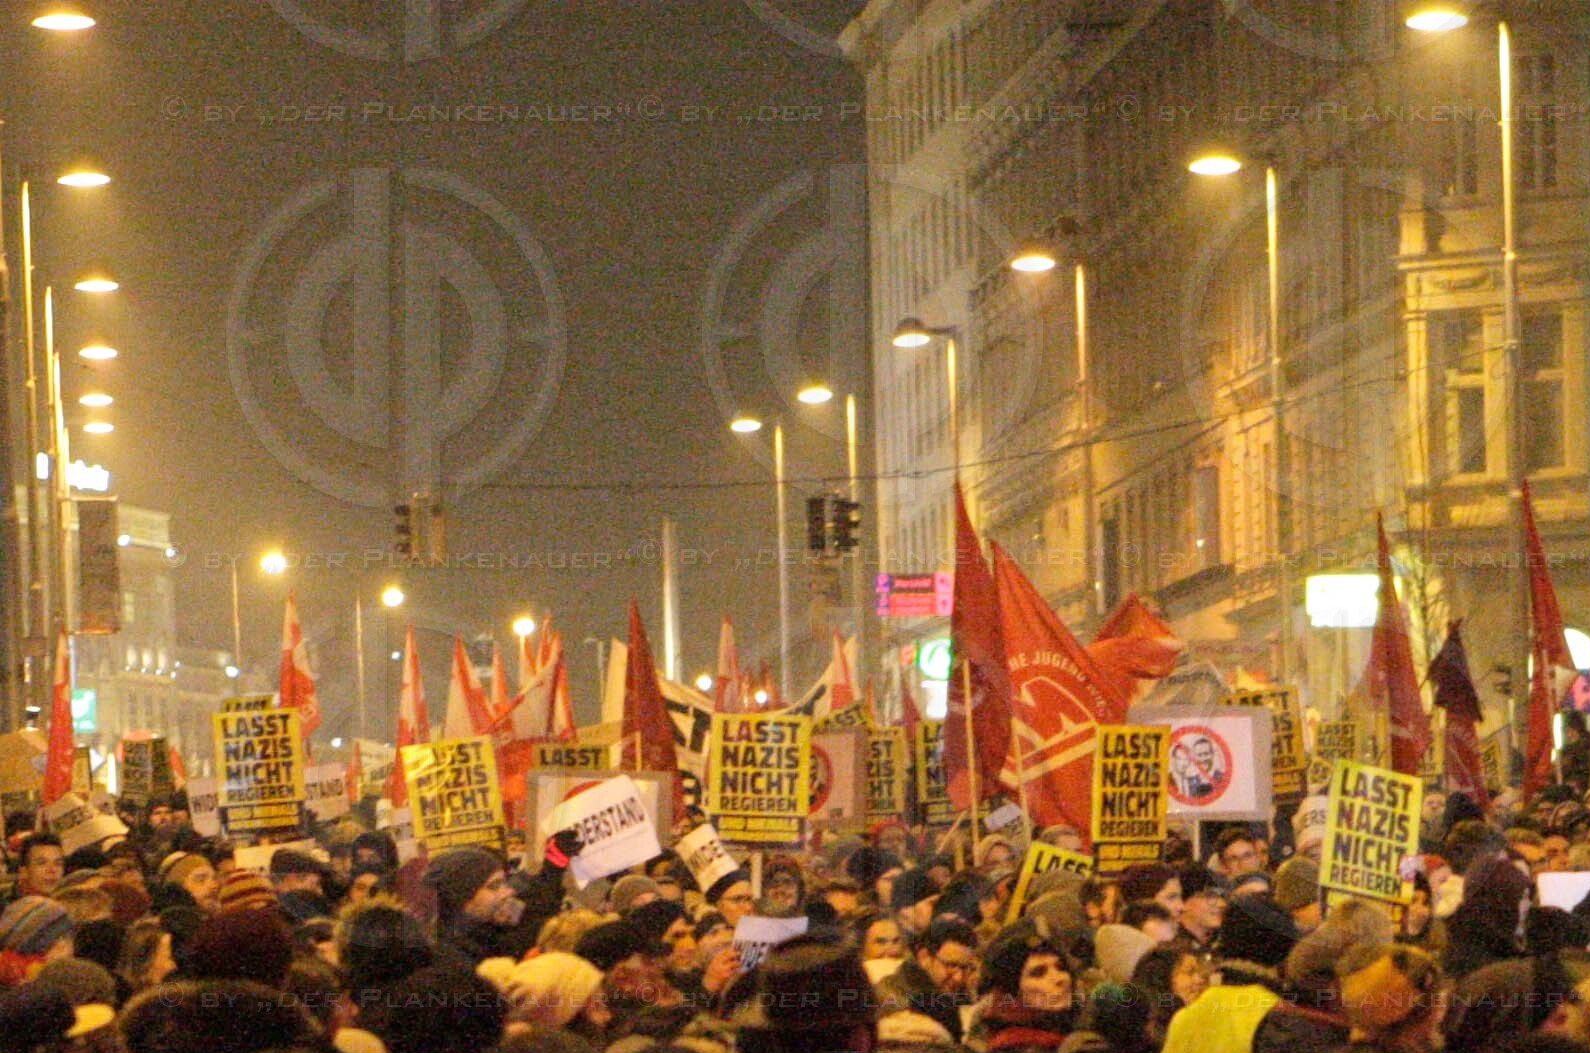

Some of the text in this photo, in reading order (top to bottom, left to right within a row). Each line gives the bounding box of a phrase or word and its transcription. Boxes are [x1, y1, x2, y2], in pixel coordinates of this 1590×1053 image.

[222, 714, 290, 739] LASST
[722, 719, 800, 743] LASST
[224, 738, 292, 762] NAZIS
[539, 747, 603, 768] LASST
[721, 745, 800, 769] NAZIS
[1103, 733, 1163, 759] LASST
[226, 761, 293, 785] NICHT
[720, 771, 799, 795] NICHT
[1101, 763, 1162, 788] NAZIS
[1340, 767, 1412, 811] LASST
[719, 797, 798, 812] REGIEREN
[1100, 791, 1160, 817] NICHT
[1099, 820, 1158, 837] REGIEREN
[1337, 801, 1410, 844] NAZIS
[1333, 832, 1407, 872] NICHT
